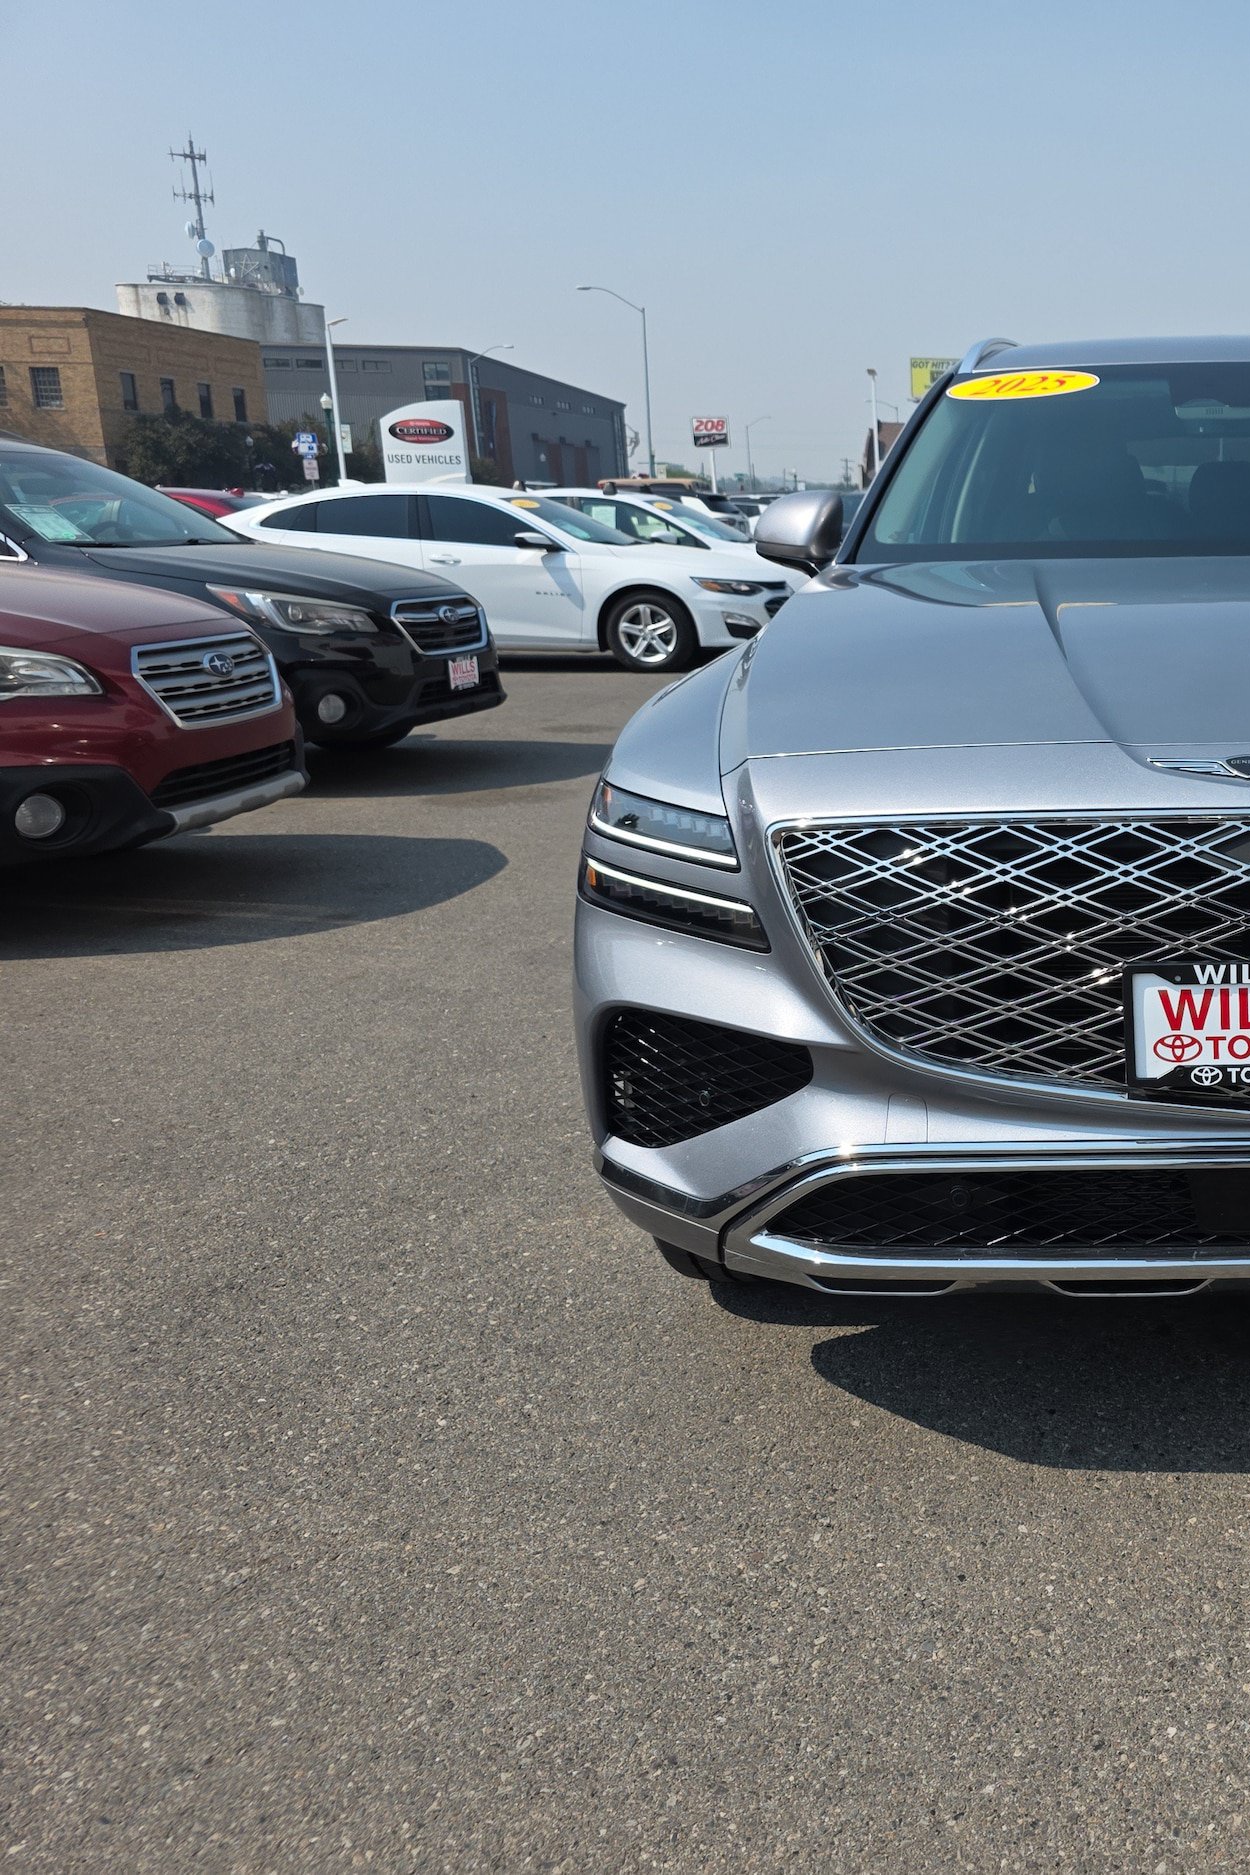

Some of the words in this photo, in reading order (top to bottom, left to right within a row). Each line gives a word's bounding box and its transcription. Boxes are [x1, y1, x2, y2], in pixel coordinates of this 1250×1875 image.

[912, 360, 929, 369] GOT
[969, 374, 1077, 396] 2025
[396, 427, 447, 435] CERTIFIED
[694, 419, 725, 432] 208
[387, 454, 413, 464] USED
[415, 455, 462, 465] VEHICLES
[452, 660, 475, 675] WILLS
